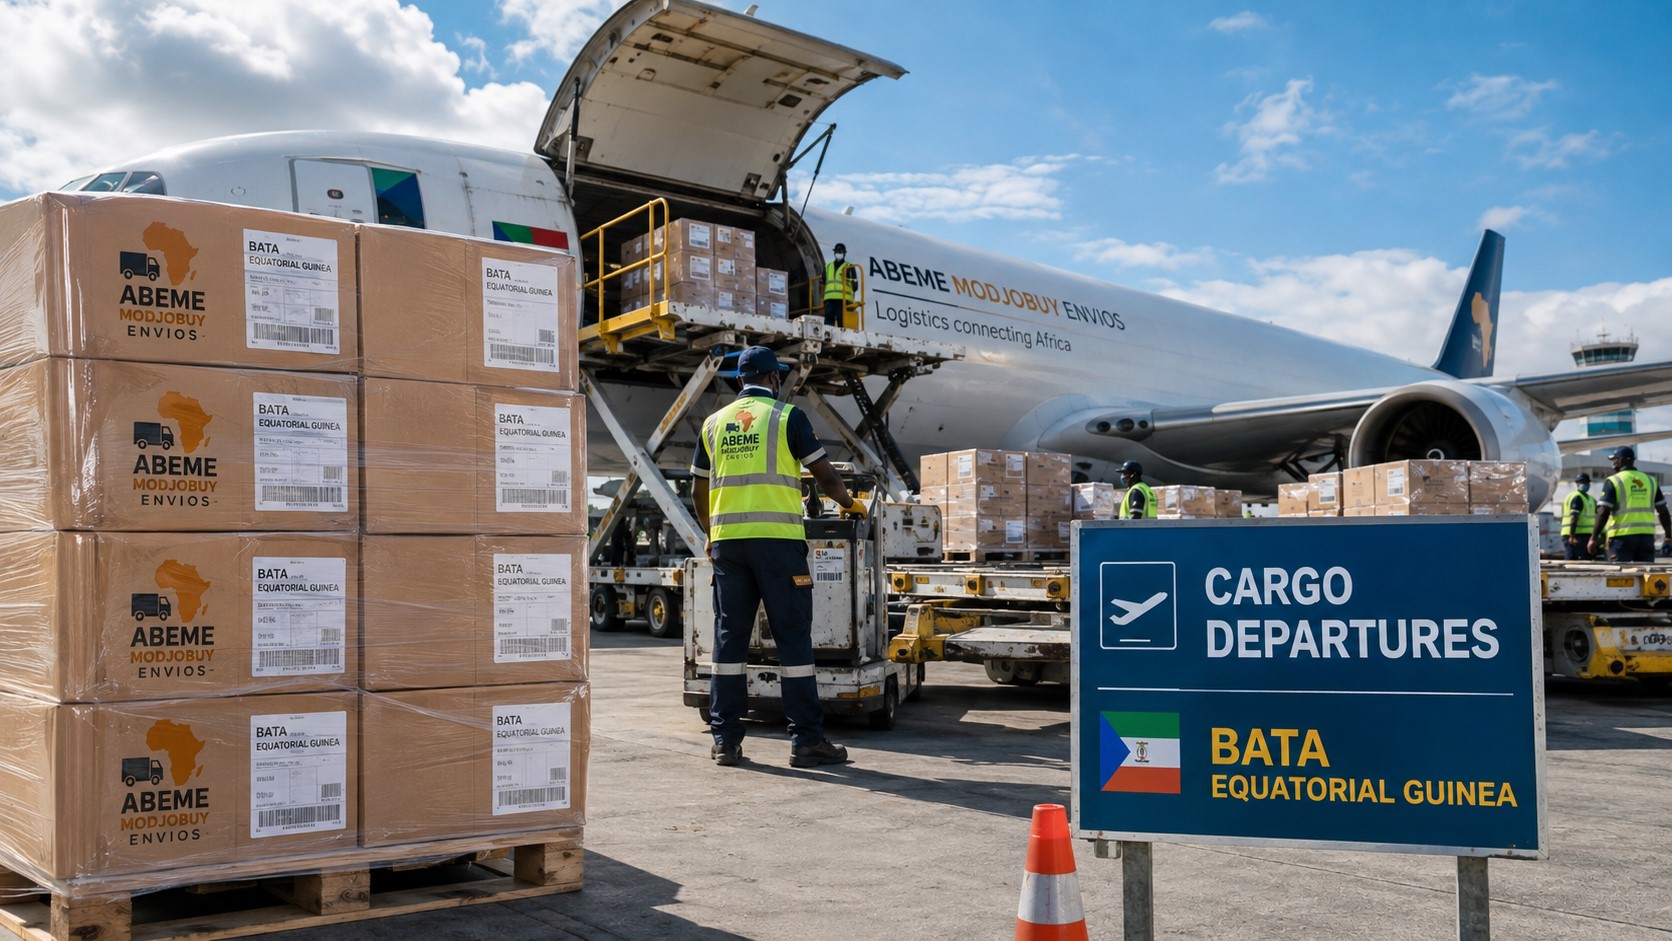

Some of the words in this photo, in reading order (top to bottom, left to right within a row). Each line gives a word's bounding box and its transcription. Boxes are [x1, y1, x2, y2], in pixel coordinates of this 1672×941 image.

[249, 241, 279, 254] BATA
[249, 256, 300, 269] EQUATORIAL
[302, 262, 332, 272] GUINEA
[486, 268, 511, 280] BATA
[487, 282, 528, 294] EQUATORIAL
[529, 287, 553, 296] GUINEA
[869, 256, 950, 293] ABEME
[951, 275, 1059, 316] MODJOBUY
[1063, 300, 1125, 330] ENVIOS
[120, 285, 206, 311] ABEME
[120, 309, 206, 326] MODJOBUY
[128, 325, 197, 340] ENVIOS
[875, 300, 949, 330] Logistics
[954, 318, 1032, 348] connecting
[1036, 331, 1072, 352] Africa
[259, 404, 289, 415] BATA
[259, 419, 310, 428] EQUATORIAL
[312, 422, 340, 430] GUINEA
[499, 414, 524, 424] BATA
[500, 428, 541, 436] EQUATORIAL
[542, 430, 566, 438] GUINEA
[721, 434, 759, 448] ABEME
[133, 454, 217, 477] ABEME
[133, 478, 217, 493] MODJOBUY
[141, 494, 210, 506] ENVIOS
[258, 569, 288, 579] BATA
[498, 564, 523, 574] BATA
[258, 584, 308, 592] EQUATORIAL
[310, 584, 339, 592] GUINEA
[1205, 566, 1352, 605] CARGO
[130, 626, 214, 647] ABEME
[1207, 618, 1500, 659] DEPARTURES
[130, 649, 214, 664] MODJOBUY
[138, 666, 206, 678] ENVIOS
[497, 716, 522, 725] BATA
[256, 726, 287, 737] BATA
[497, 728, 539, 738] EQUATORIAL
[540, 727, 565, 735] GUINEA
[256, 740, 308, 751] EQUATORIAL
[310, 738, 340, 747] GUINEA
[1211, 727, 1330, 768] BATA
[1212, 774, 1396, 804] EQUATORIAL
[1404, 780, 1518, 808] GUINEA
[121, 788, 209, 814] ABEME
[120, 812, 209, 831] MODJOBUY
[129, 829, 200, 846] ENVIOS
